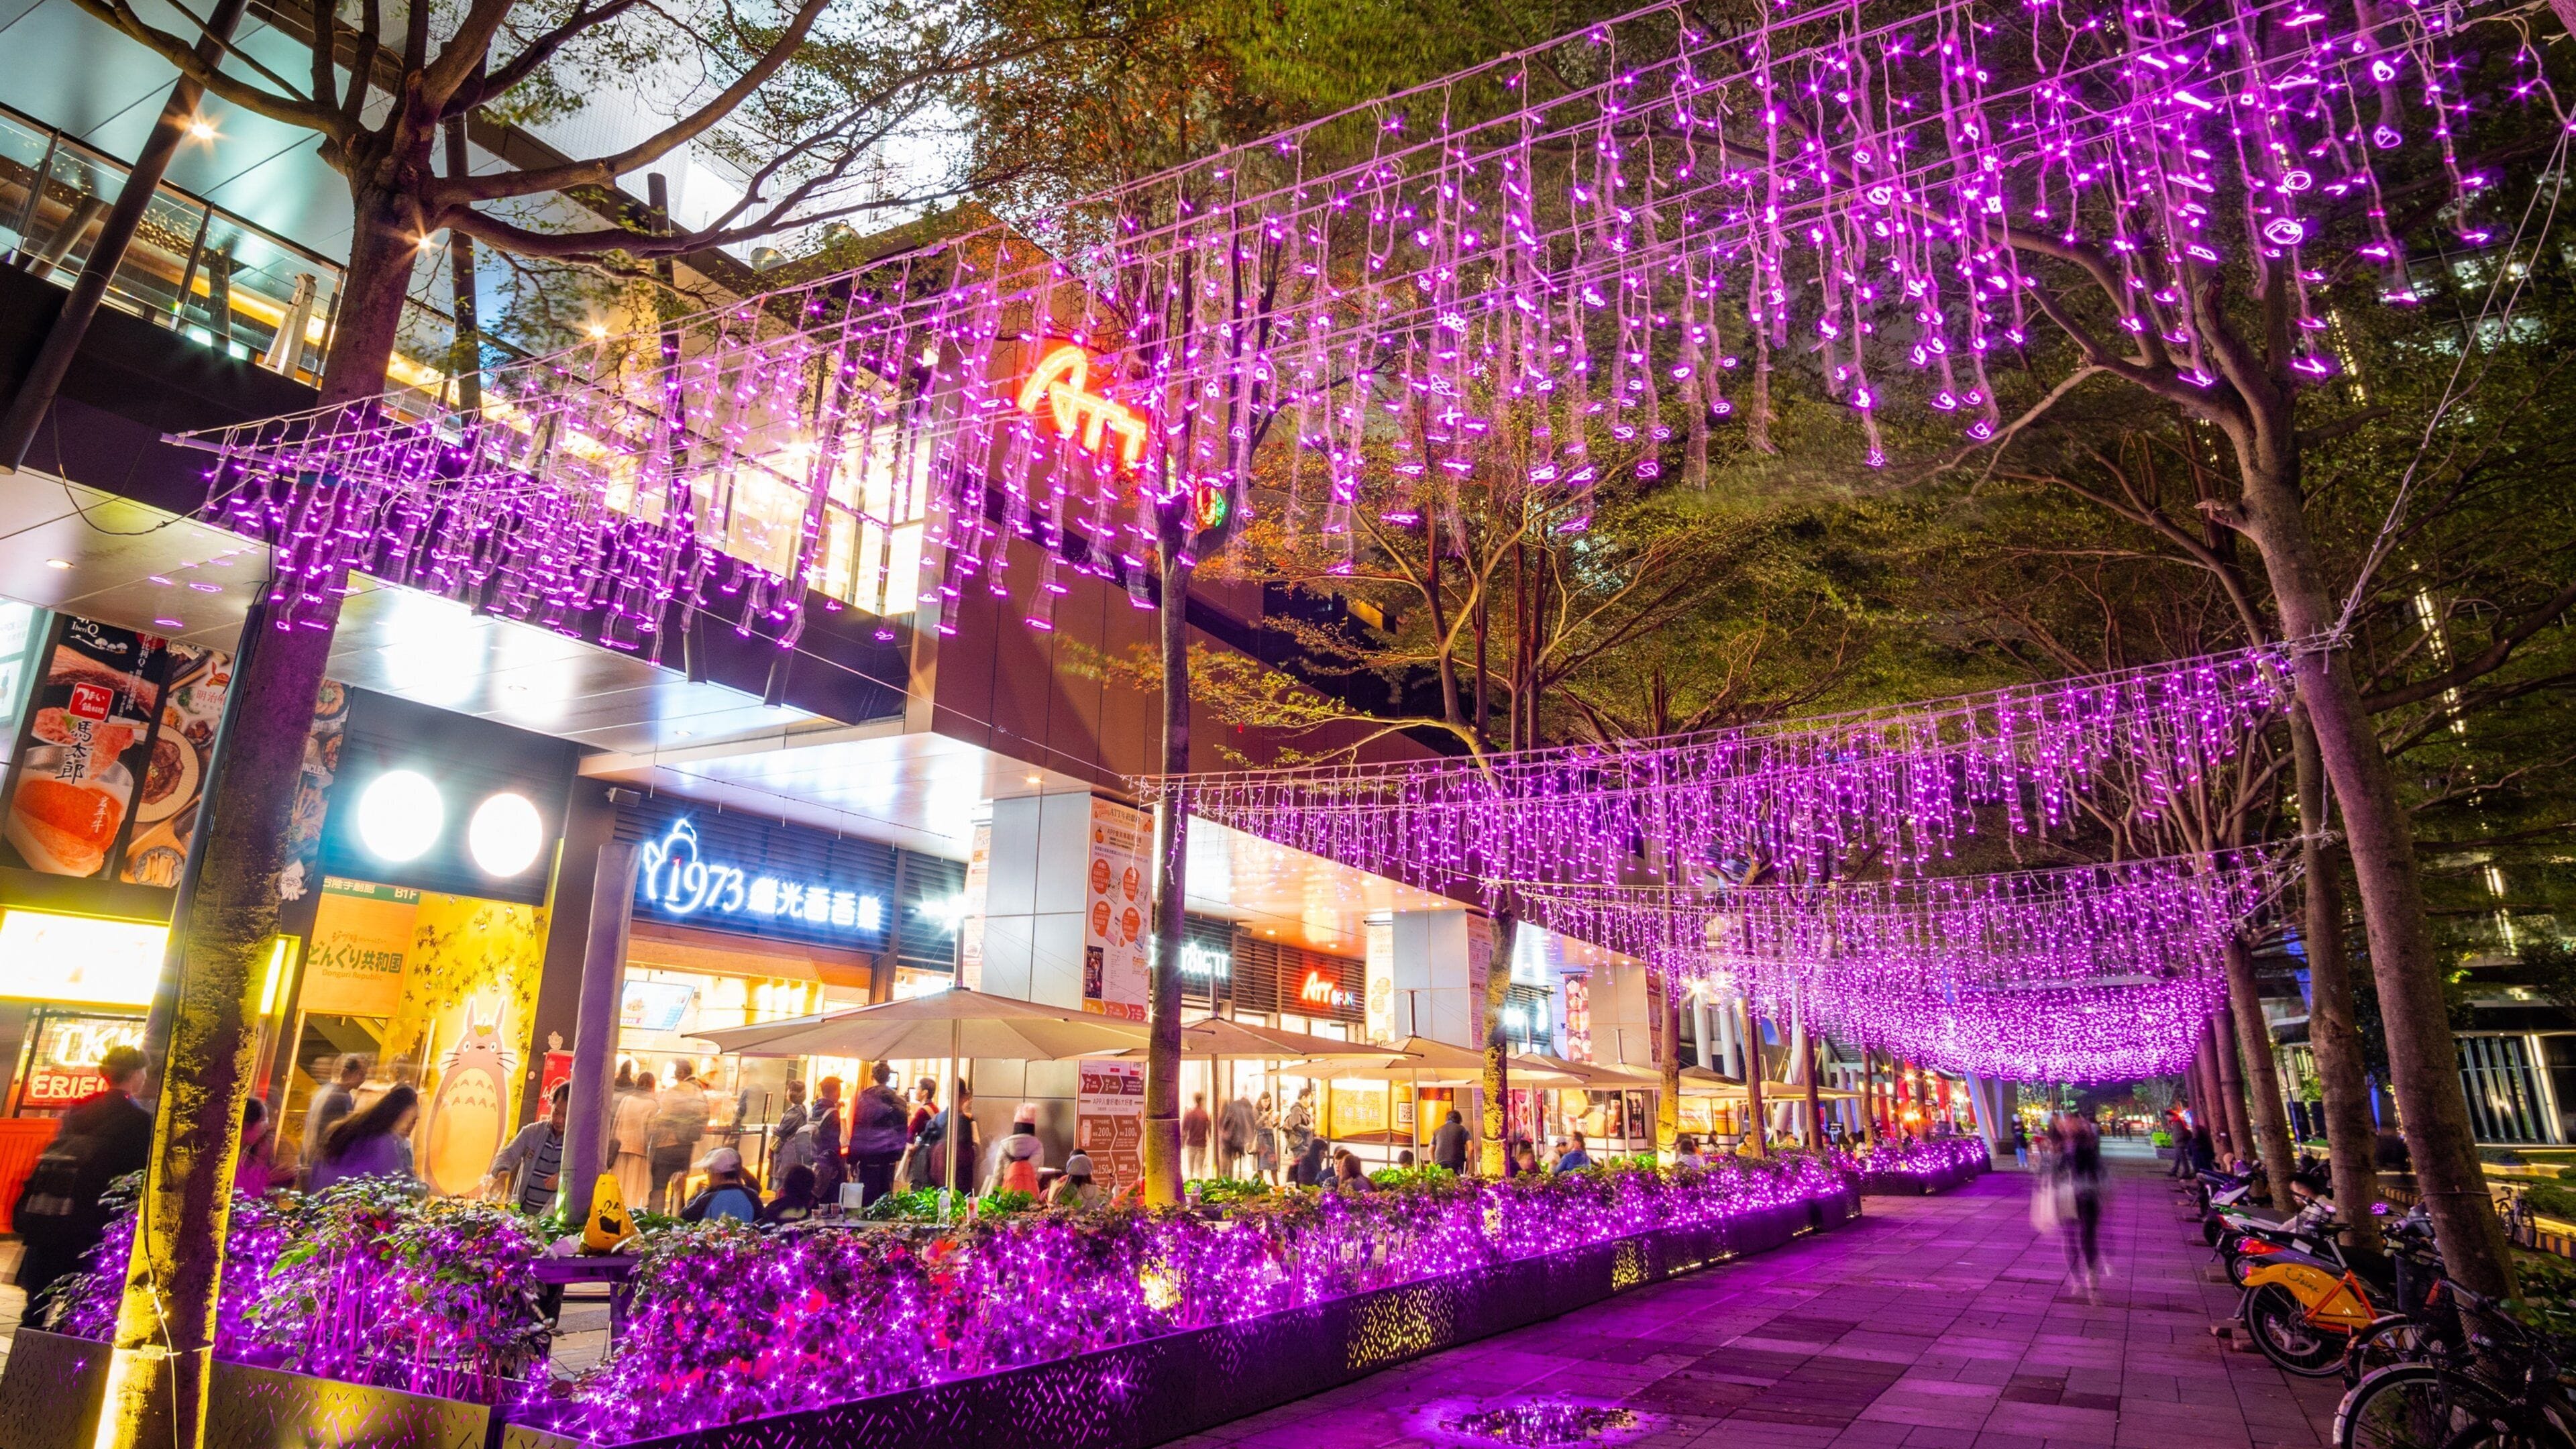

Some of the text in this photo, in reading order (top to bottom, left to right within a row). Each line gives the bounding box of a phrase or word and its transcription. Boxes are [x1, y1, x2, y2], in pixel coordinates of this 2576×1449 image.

[55, 720, 93, 784] 馬太郎
[394, 888, 417, 900] B1F
[664, 857, 744, 914] 1973
[305, 941, 404, 973] どんぐり共和国
[322, 969, 383, 981] Donguri Republic
